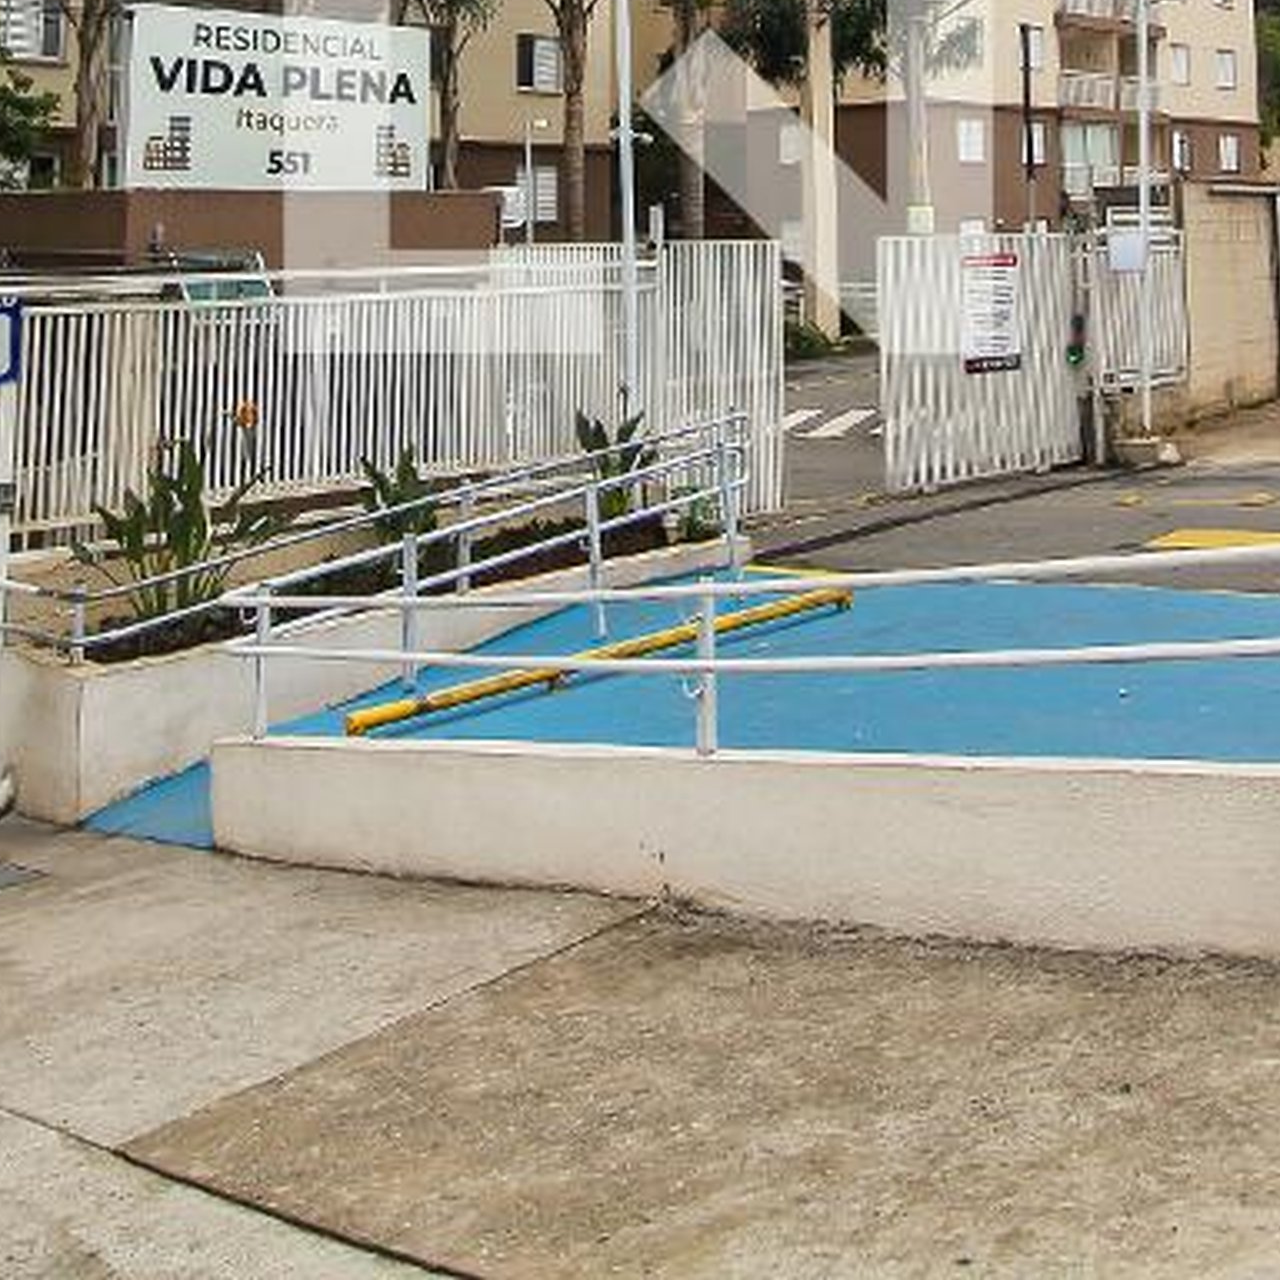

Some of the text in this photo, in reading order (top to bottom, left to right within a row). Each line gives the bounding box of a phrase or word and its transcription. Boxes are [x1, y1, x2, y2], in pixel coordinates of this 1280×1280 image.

[193, 23, 382, 61] RESIDENCIAL
[150, 56, 417, 105] VIDA PLENA
[236, 108, 340, 136] Itaquera
[266, 150, 312, 175] 551
